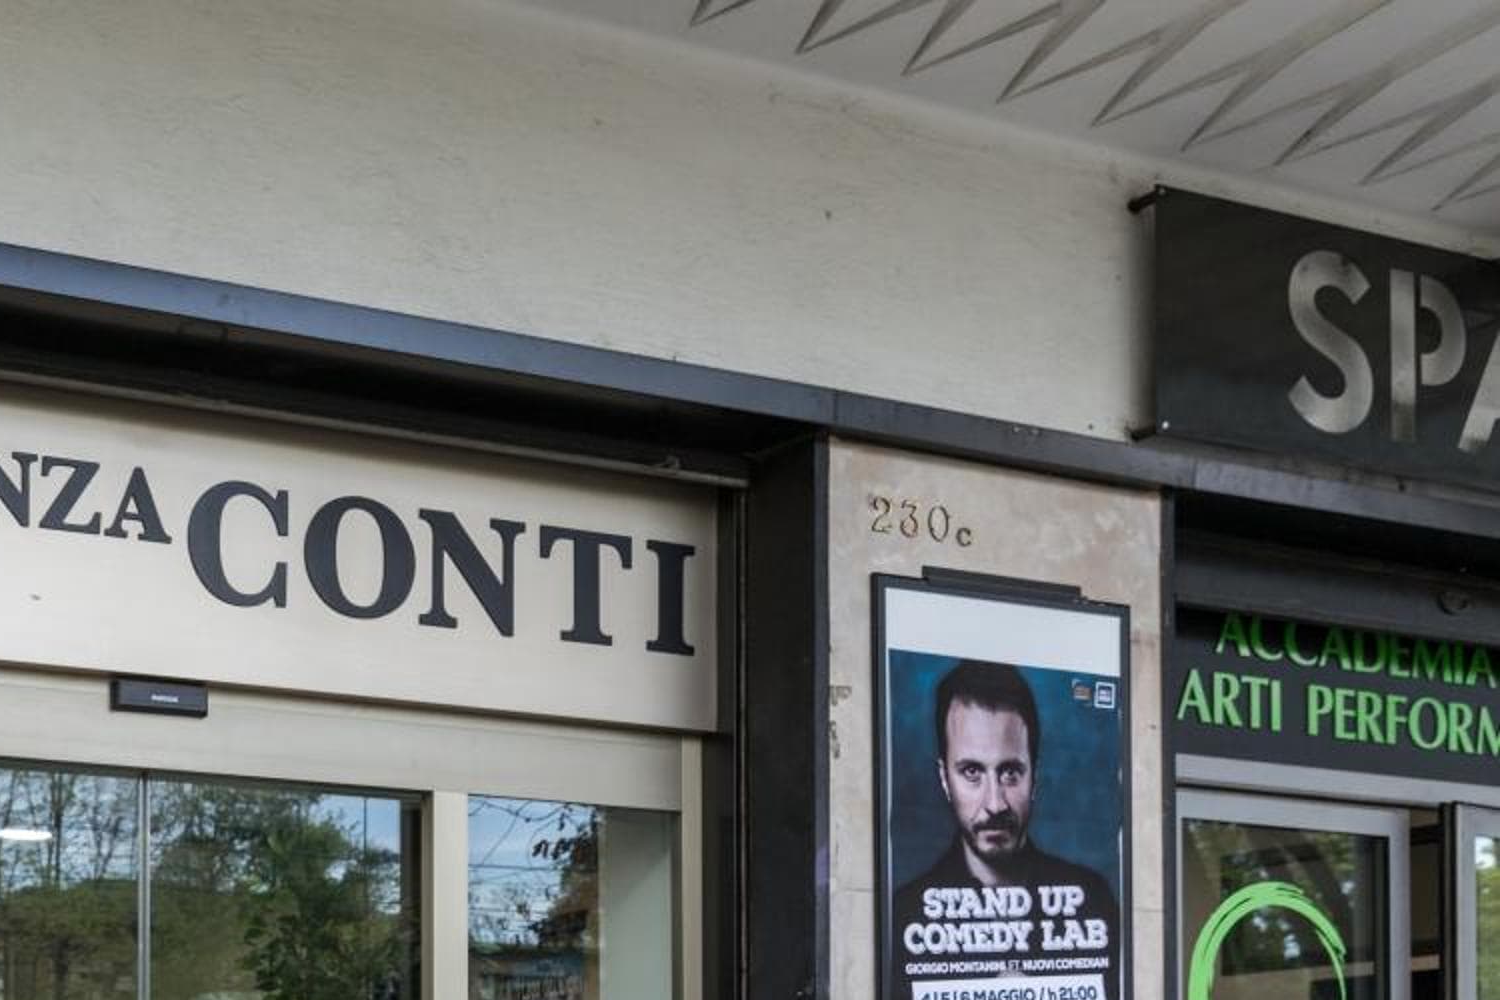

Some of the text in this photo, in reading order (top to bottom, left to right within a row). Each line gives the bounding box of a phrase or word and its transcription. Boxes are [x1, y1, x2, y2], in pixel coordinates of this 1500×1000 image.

[186, 479, 696, 657] CONTI
[1215, 610, 1498, 689] ACCADEMIA
[1176, 667, 1282, 732] ARTI
[923, 884, 1084, 919] STAND UP
[903, 917, 1109, 954] COMEDY LAB
